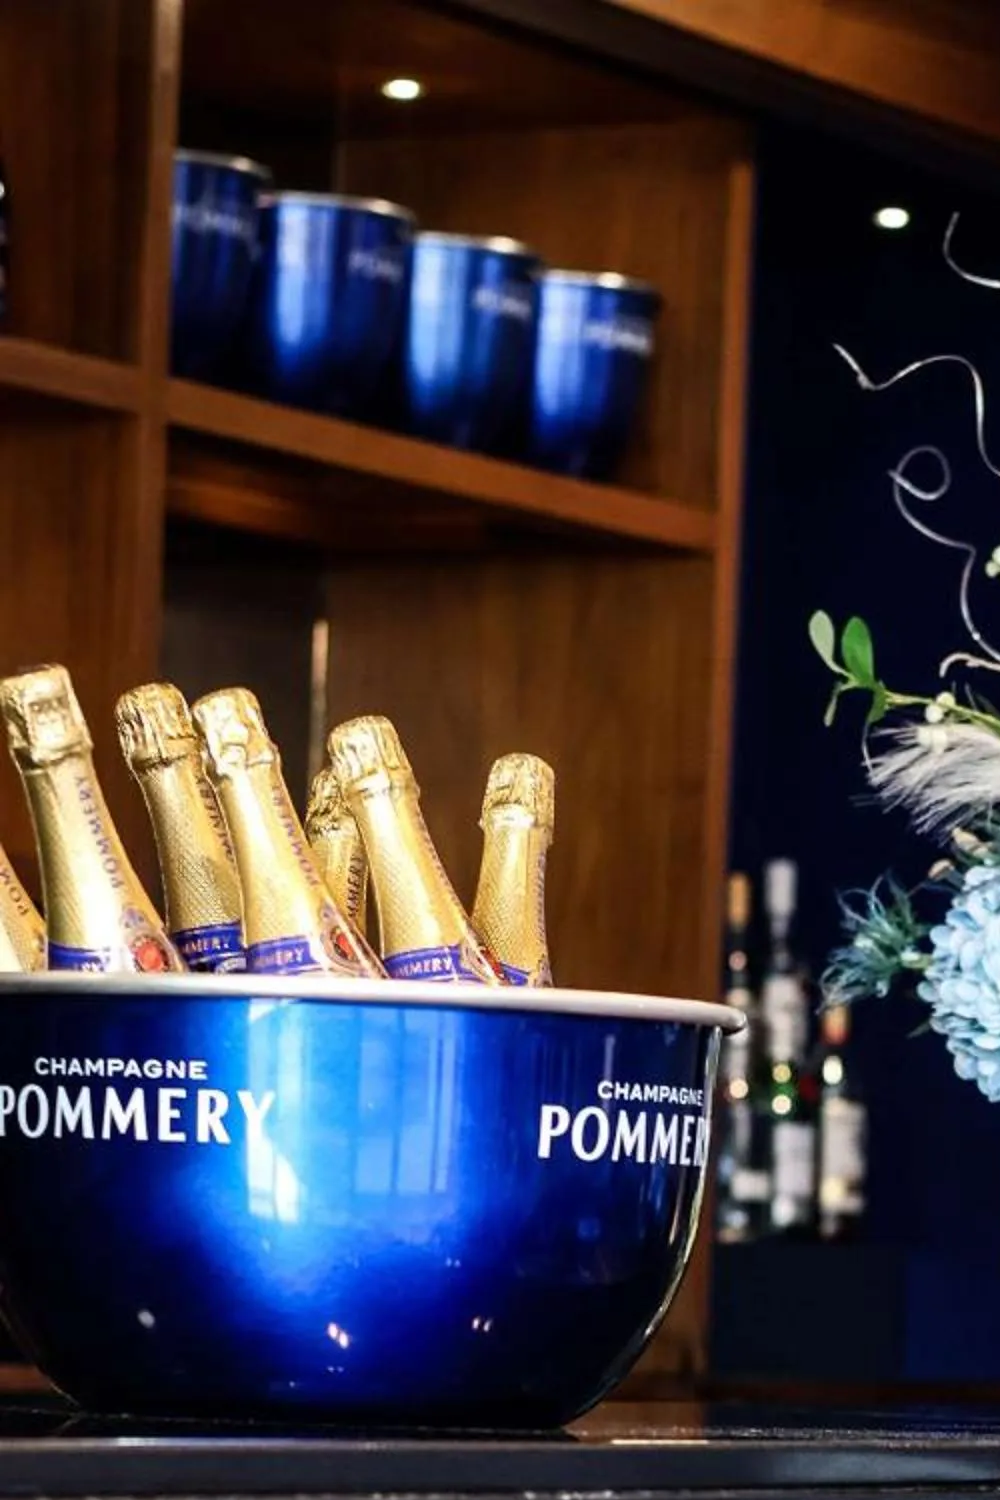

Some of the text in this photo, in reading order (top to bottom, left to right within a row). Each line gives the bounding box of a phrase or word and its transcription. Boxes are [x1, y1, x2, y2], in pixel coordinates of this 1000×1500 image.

[34, 1057, 208, 1081] CHAMPAGNE
[598, 1080, 704, 1107] CHAMPAGNE
[0, 1083, 276, 1146] POMMERY
